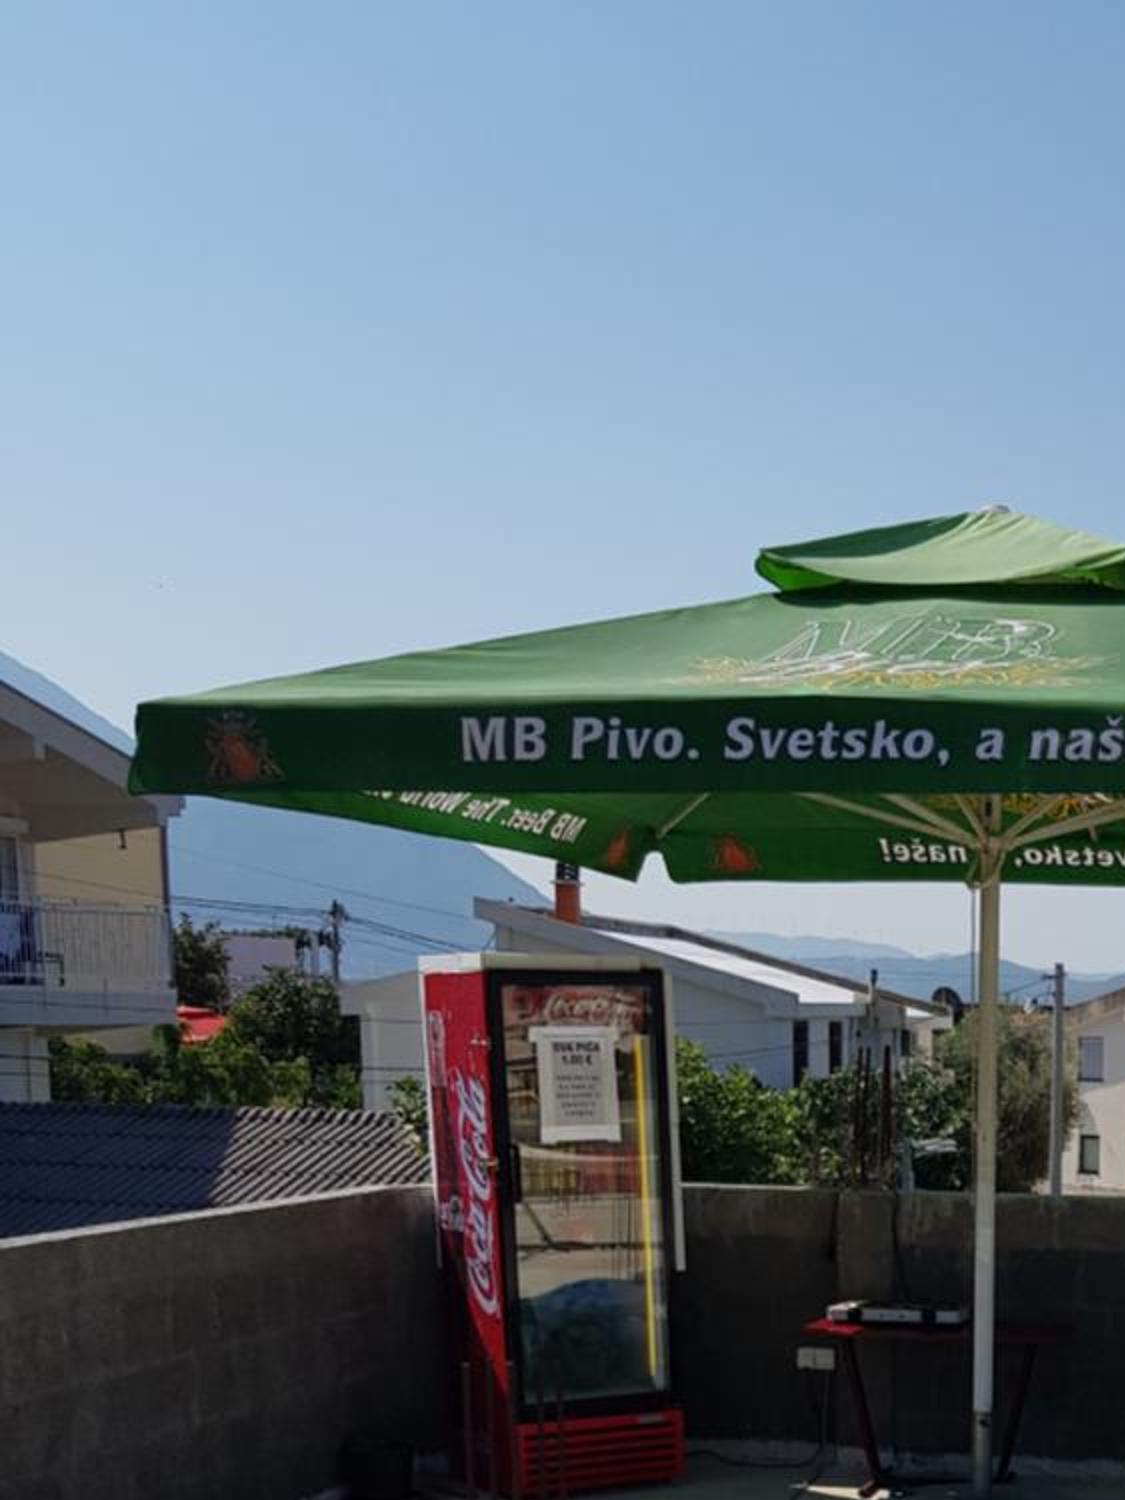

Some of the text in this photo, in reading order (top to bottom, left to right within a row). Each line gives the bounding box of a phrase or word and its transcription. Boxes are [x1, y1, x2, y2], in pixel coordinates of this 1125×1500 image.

[461, 716, 547, 762] MB
[571, 716, 700, 761] Pivo.
[724, 716, 950, 767] Svetsko,
[975, 728, 1005, 760] a
